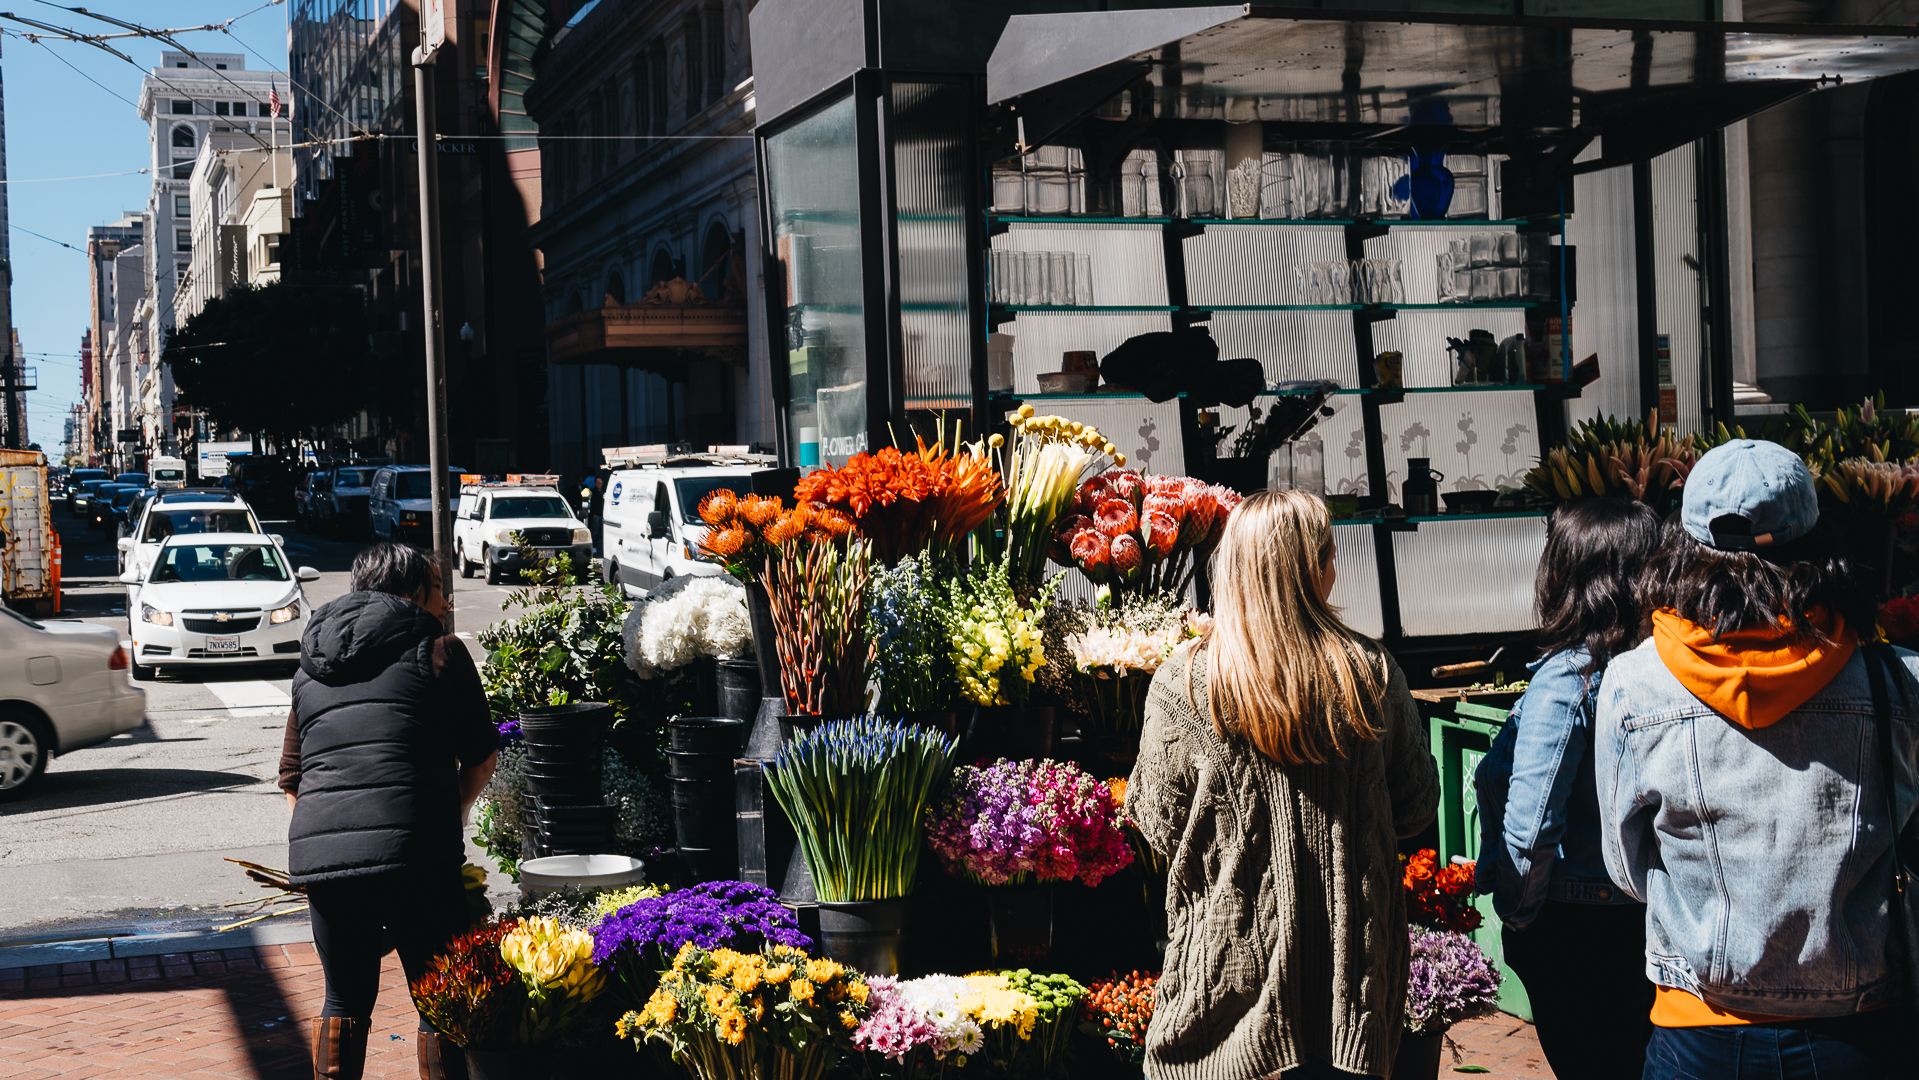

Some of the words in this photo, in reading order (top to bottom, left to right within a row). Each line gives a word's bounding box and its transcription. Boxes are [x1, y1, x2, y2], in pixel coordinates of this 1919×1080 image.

[412, 141, 476, 153] COCKER
[340, 168, 348, 230] MONTGOMERY
[208, 641, 237, 649] 7NXW585
